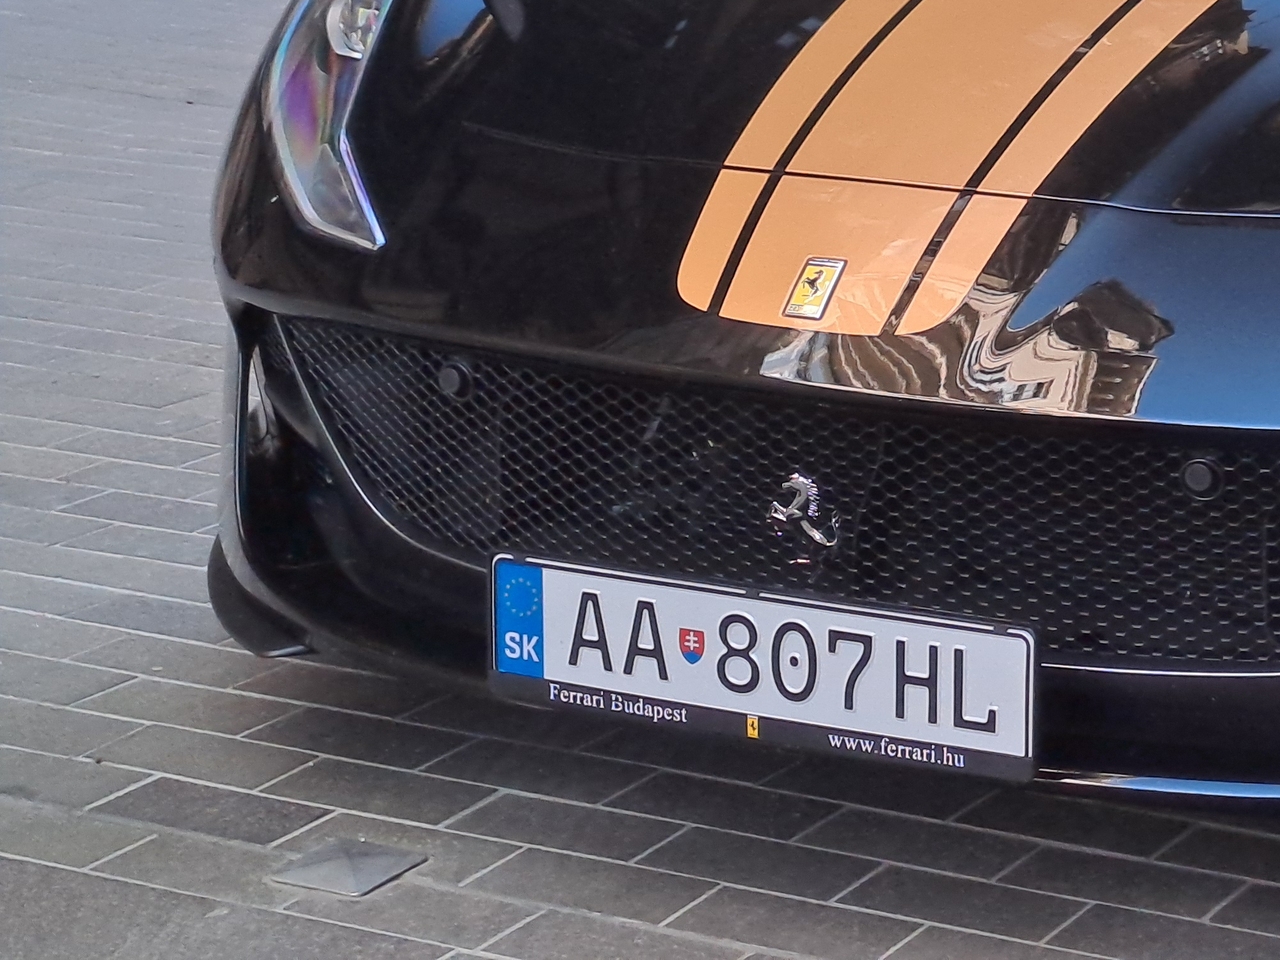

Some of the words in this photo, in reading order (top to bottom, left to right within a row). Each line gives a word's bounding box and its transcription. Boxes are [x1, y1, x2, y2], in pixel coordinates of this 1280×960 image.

[503, 630, 540, 663] SK
[568, 588, 669, 681] AA
[548, 683, 606, 710] Ferrari
[610, 691, 688, 724] Budapest
[828, 731, 966, 769] www.ferrari.hu
